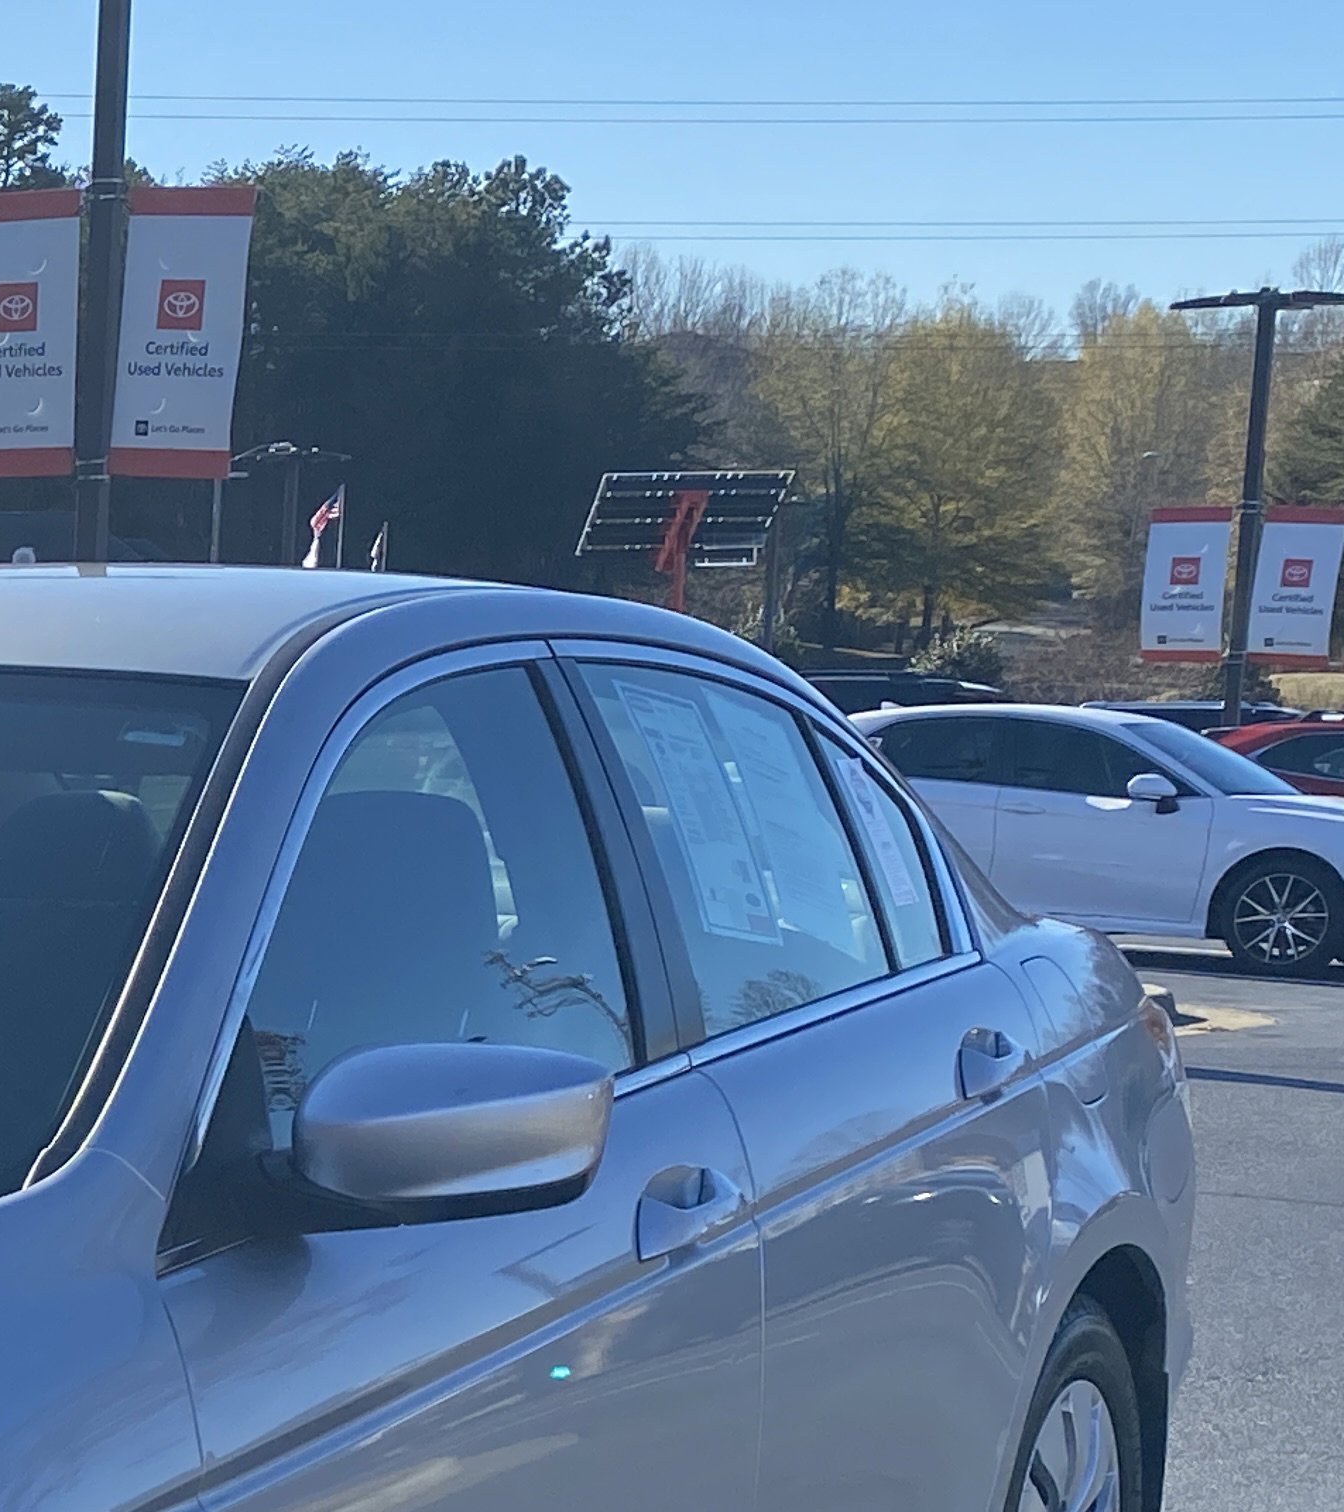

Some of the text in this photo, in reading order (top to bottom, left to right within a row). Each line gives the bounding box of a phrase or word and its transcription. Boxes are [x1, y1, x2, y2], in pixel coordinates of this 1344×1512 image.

[145, 341, 210, 357] Certified
[4, 362, 63, 378] Vehicles
[127, 361, 224, 378] Used Vehicles
